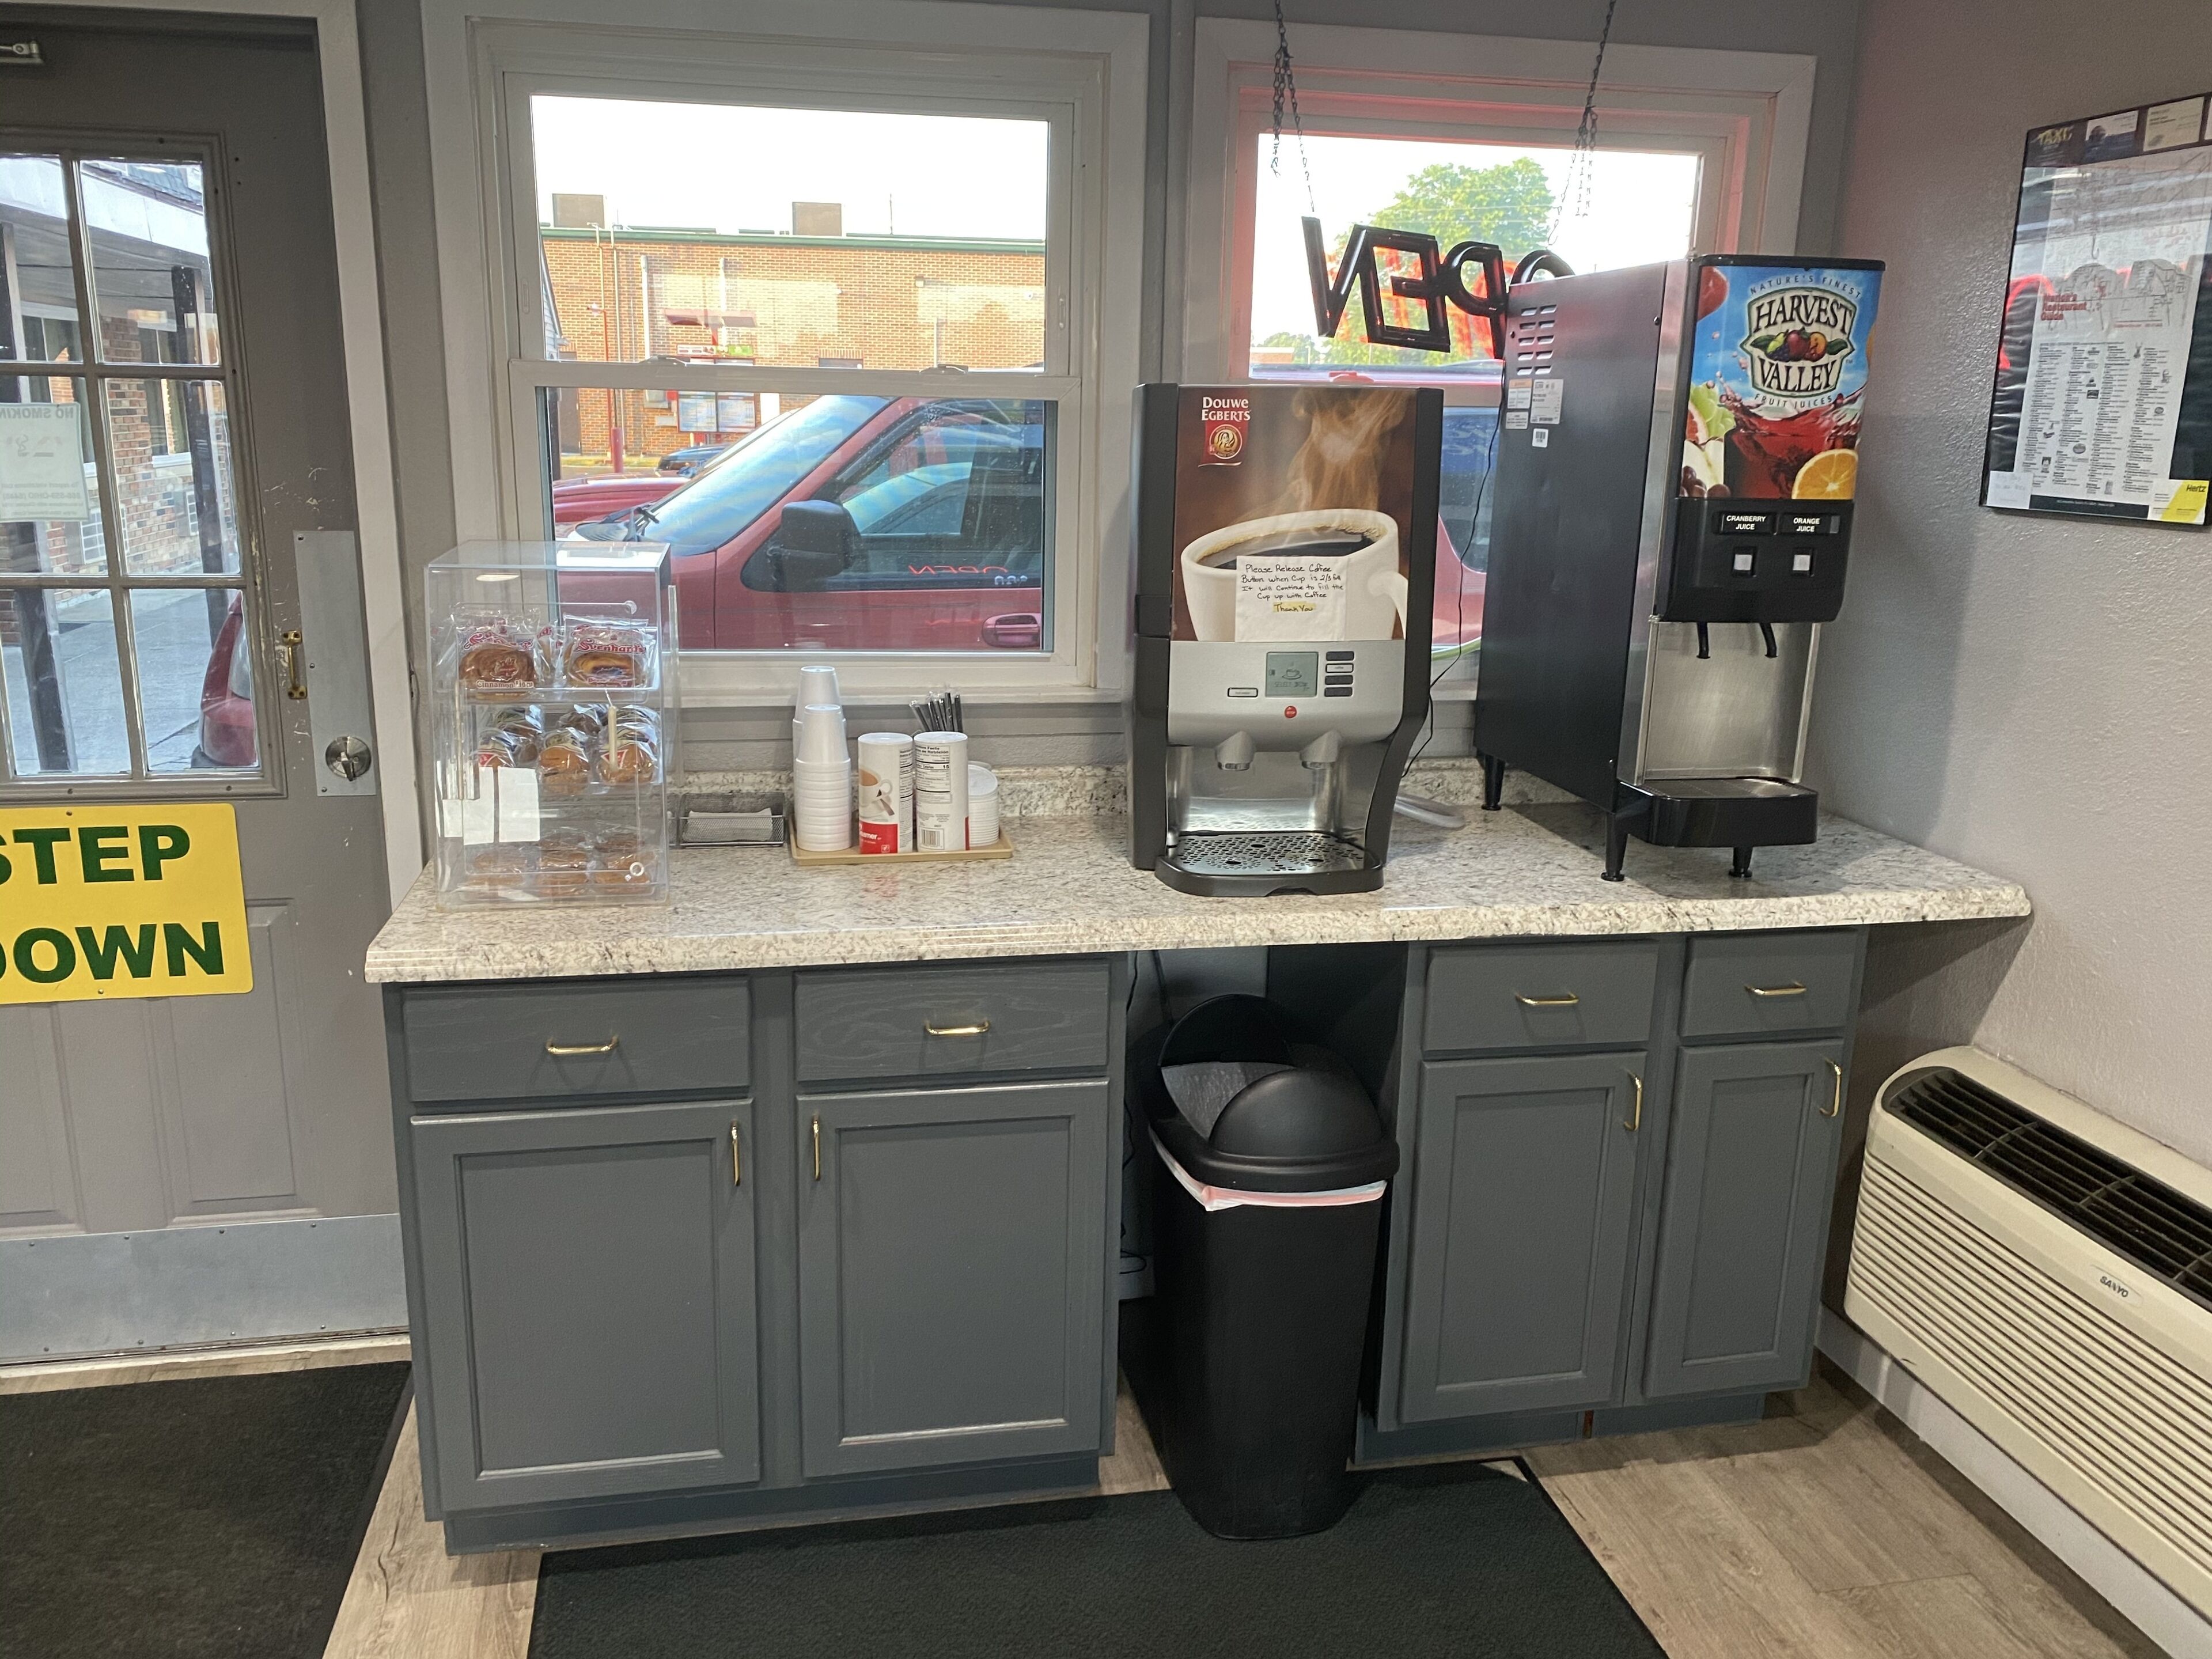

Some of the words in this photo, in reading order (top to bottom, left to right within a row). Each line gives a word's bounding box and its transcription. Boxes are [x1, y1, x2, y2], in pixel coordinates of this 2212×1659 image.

[1751, 275, 1813, 294] NATURE'S
[1823, 277, 1861, 298] FINEST
[1753, 295, 1853, 335] HARVEST
[1758, 355, 1837, 392] VALLEY
[1203, 396, 1249, 408] Douwe
[1755, 394, 1787, 407] FRUIT
[1795, 395, 1832, 408] JUICES
[1202, 409, 1251, 422] EGBERTS
[2186, 484, 2206, 493] Hertz
[1246, 565, 1272, 573] Please
[1241, 575, 1264, 583] Button
[1320, 574, 1331, 582] 2/3
[1274, 603, 1298, 612] Thank
[576, 638, 646, 654] Svenhard's
[476, 680, 514, 688] Cinnamon
[0, 825, 190, 885] TEP
[0, 922, 224, 983] OWN
[2100, 1276, 2128, 1298] SANYO
